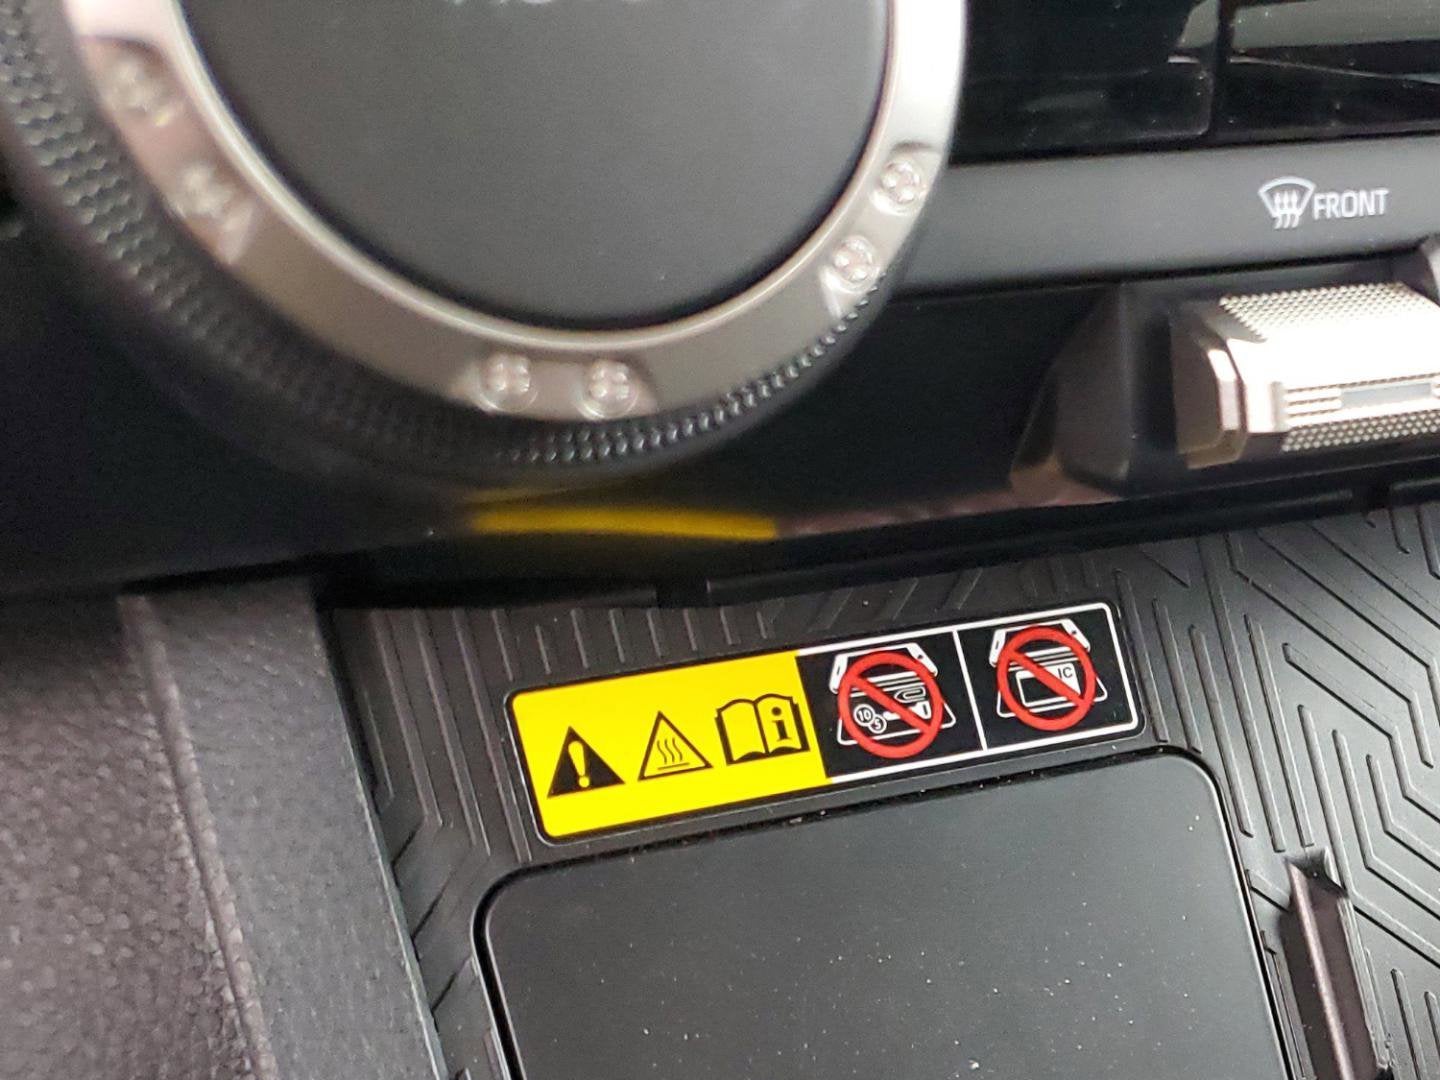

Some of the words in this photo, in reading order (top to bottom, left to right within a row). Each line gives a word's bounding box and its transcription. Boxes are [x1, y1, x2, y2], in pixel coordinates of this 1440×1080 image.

[1313, 187, 1389, 220] FRONT
[1057, 666, 1073, 679] IC
[857, 707, 872, 722] 10
